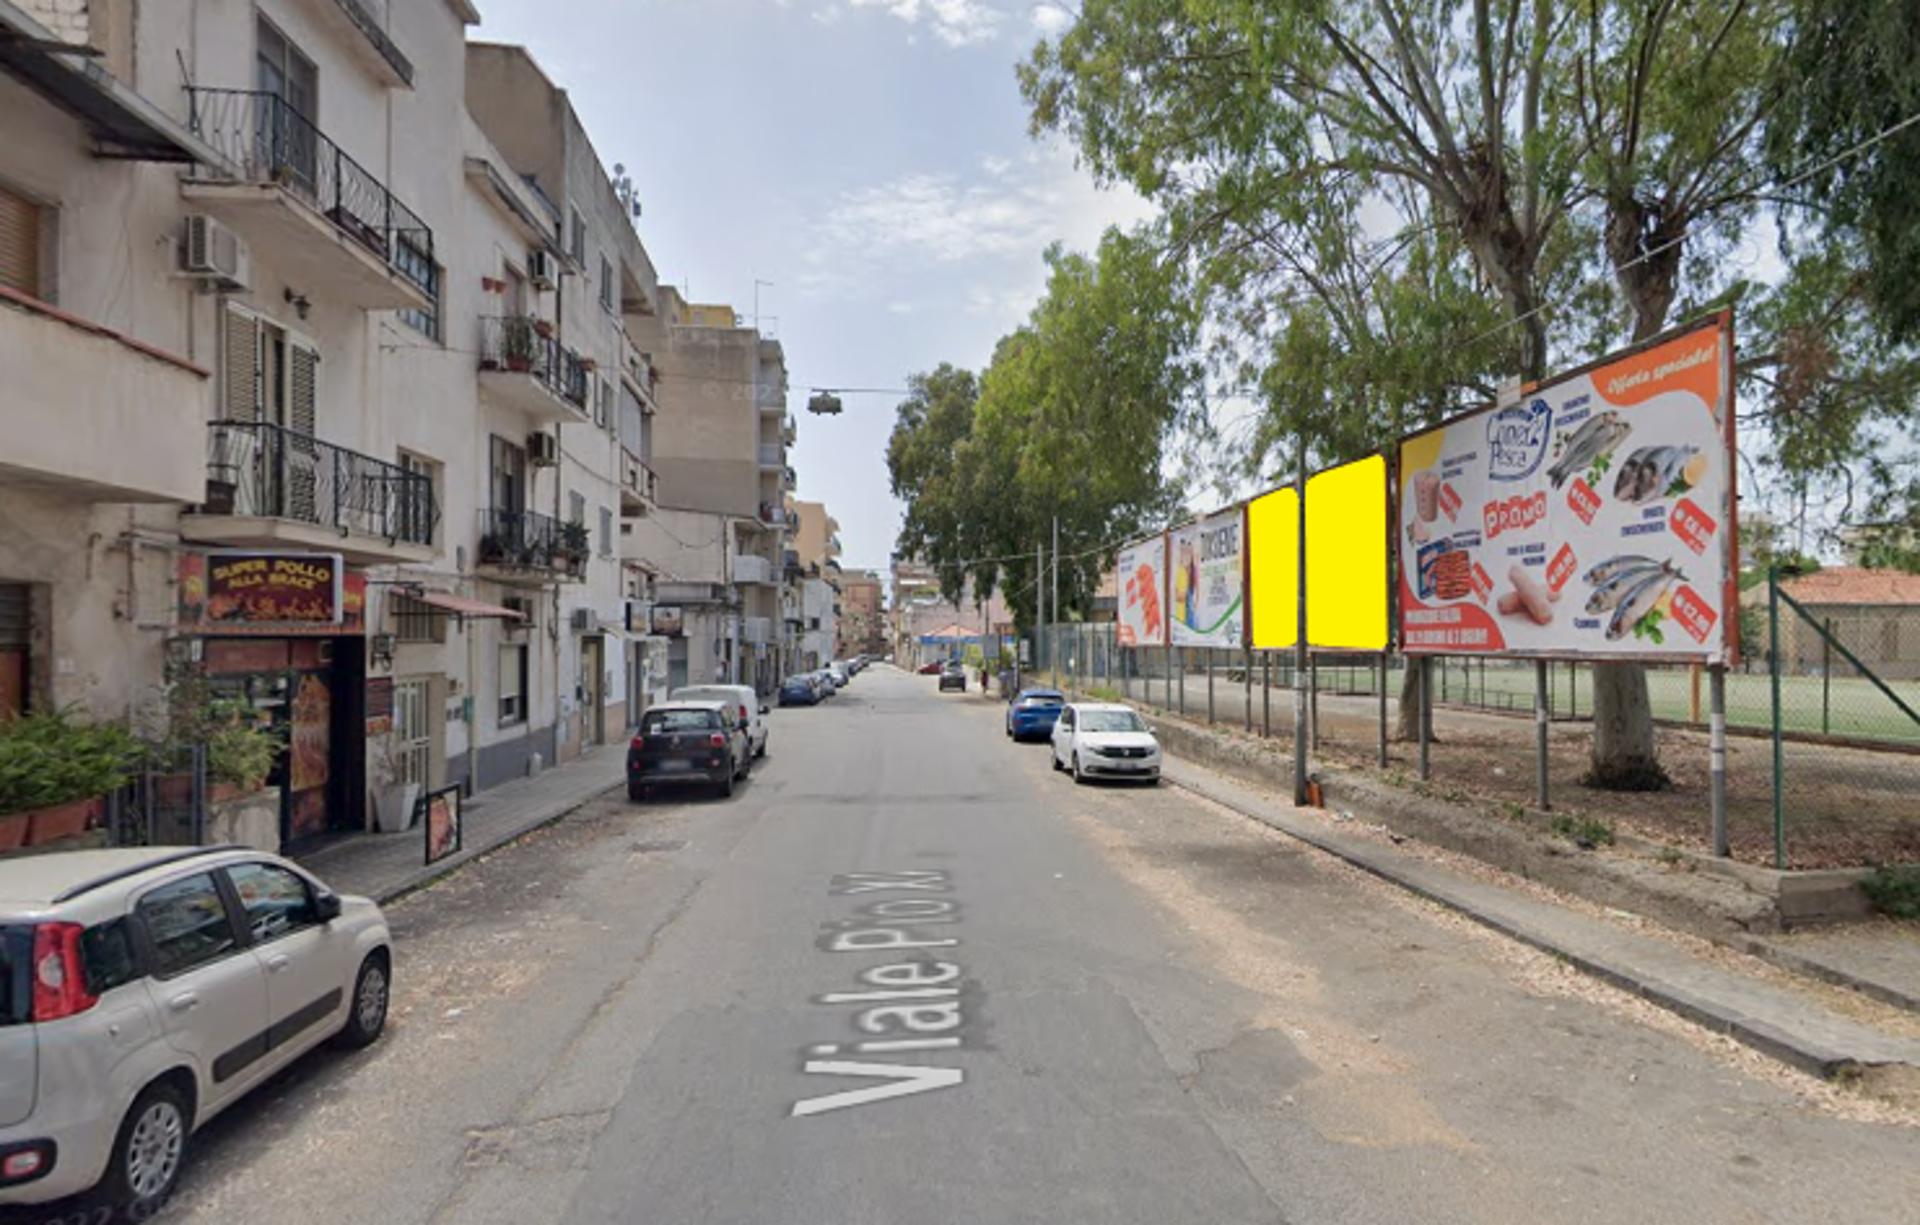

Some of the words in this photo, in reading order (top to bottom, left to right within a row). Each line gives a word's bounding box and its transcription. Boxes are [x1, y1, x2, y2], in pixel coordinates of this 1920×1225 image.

[212, 560, 268, 580] SUPER
[274, 560, 331, 582] POLLO
[228, 575, 263, 590] ALLA
[268, 572, 316, 590] BRACE
